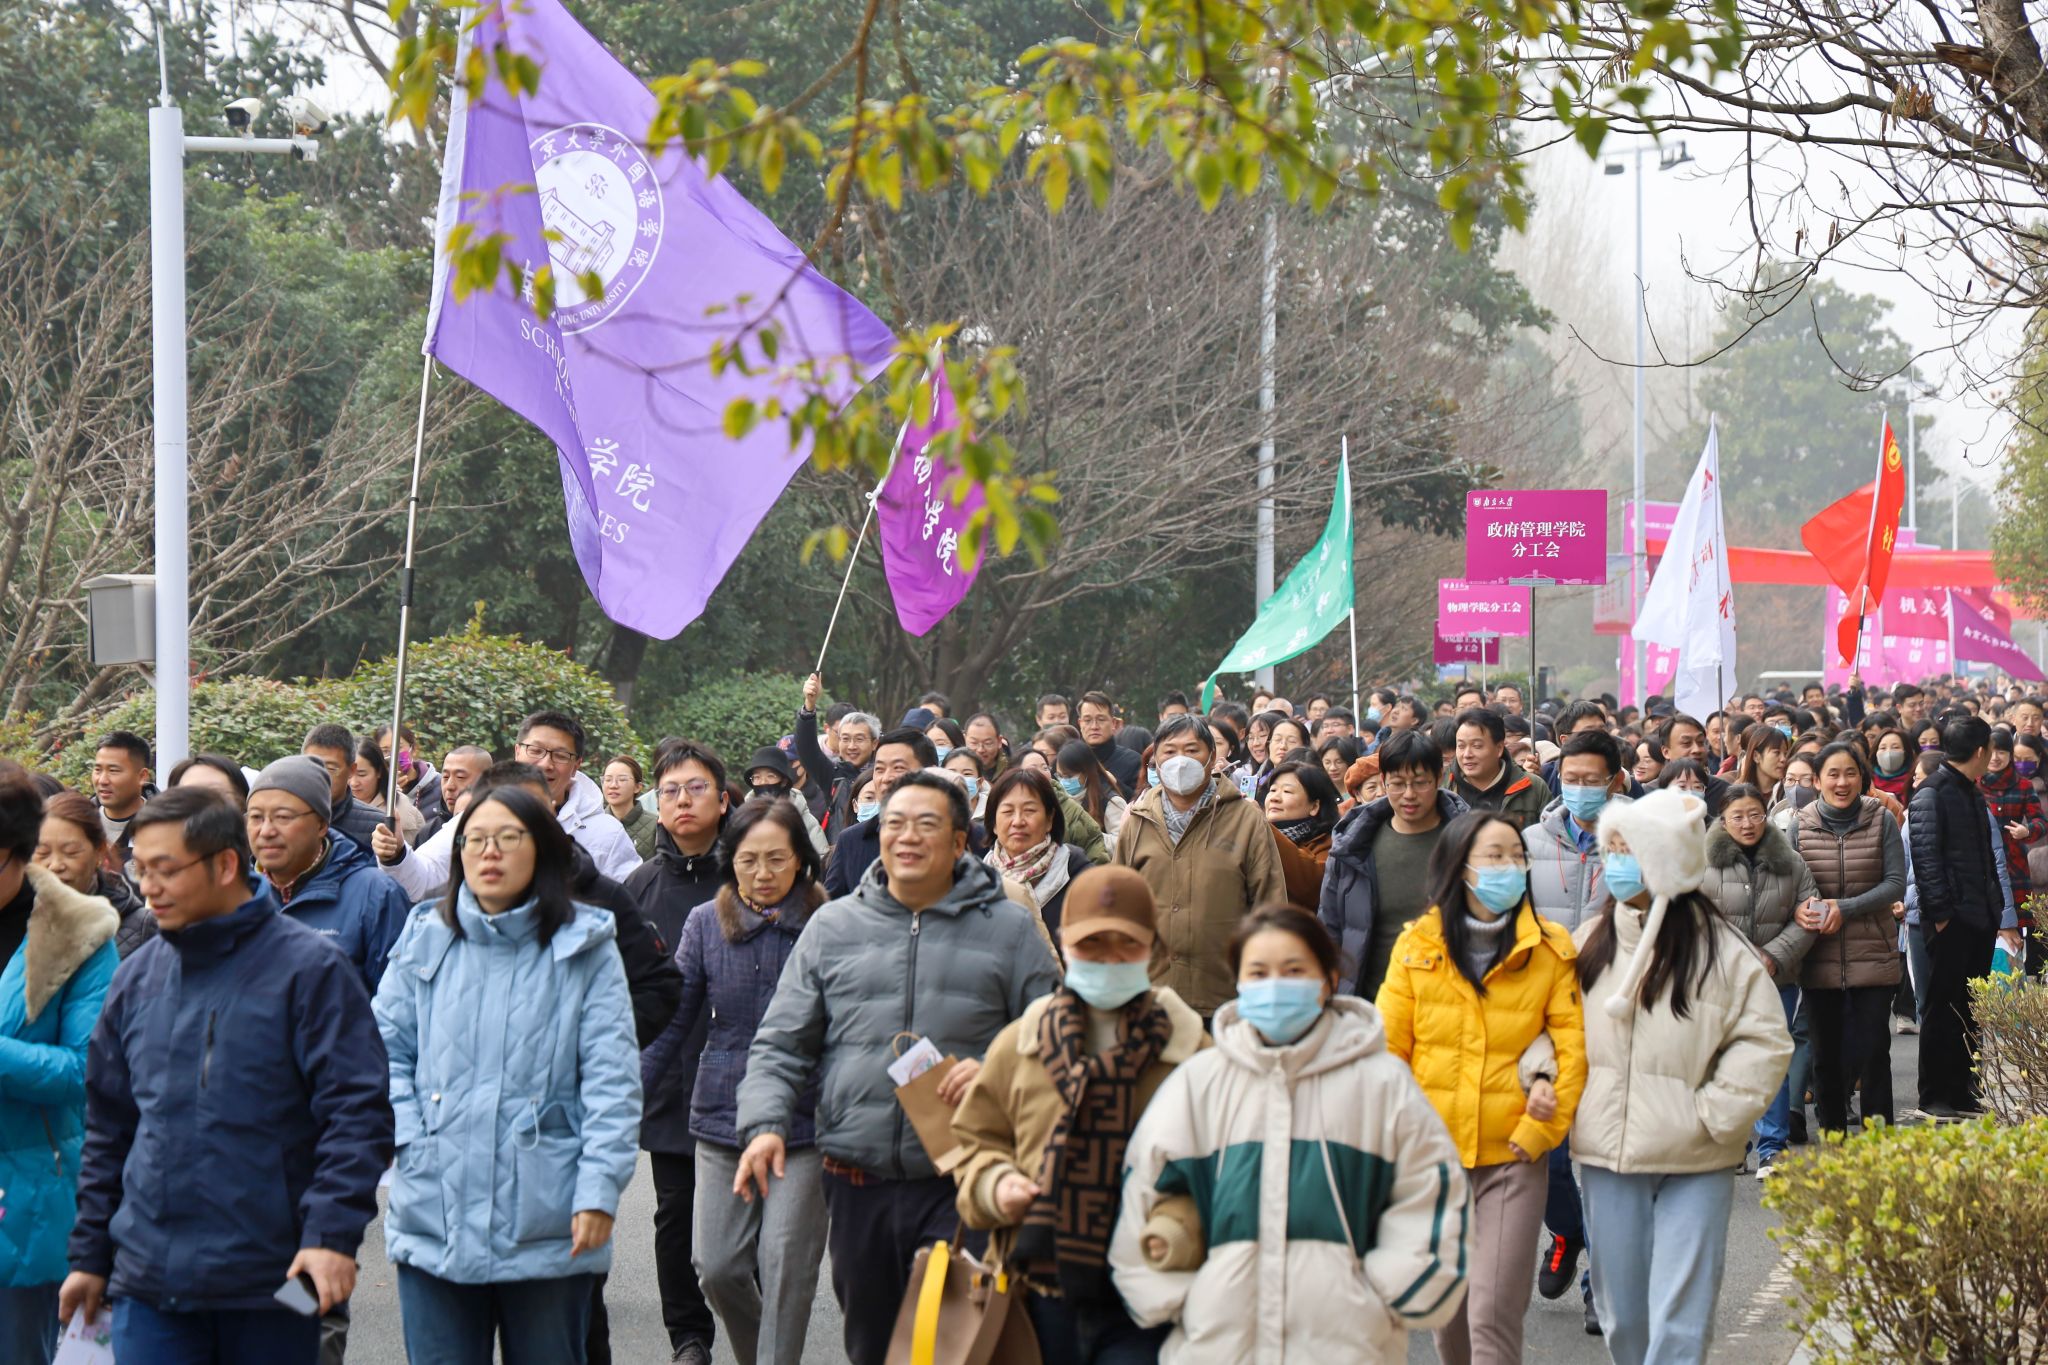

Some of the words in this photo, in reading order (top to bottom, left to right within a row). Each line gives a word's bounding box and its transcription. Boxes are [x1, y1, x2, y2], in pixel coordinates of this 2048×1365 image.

[1487, 521, 1586, 538] 政府管理学院
[1511, 541, 1561, 558] 分工会
[1446, 602, 1522, 613] 物理学院分工会
